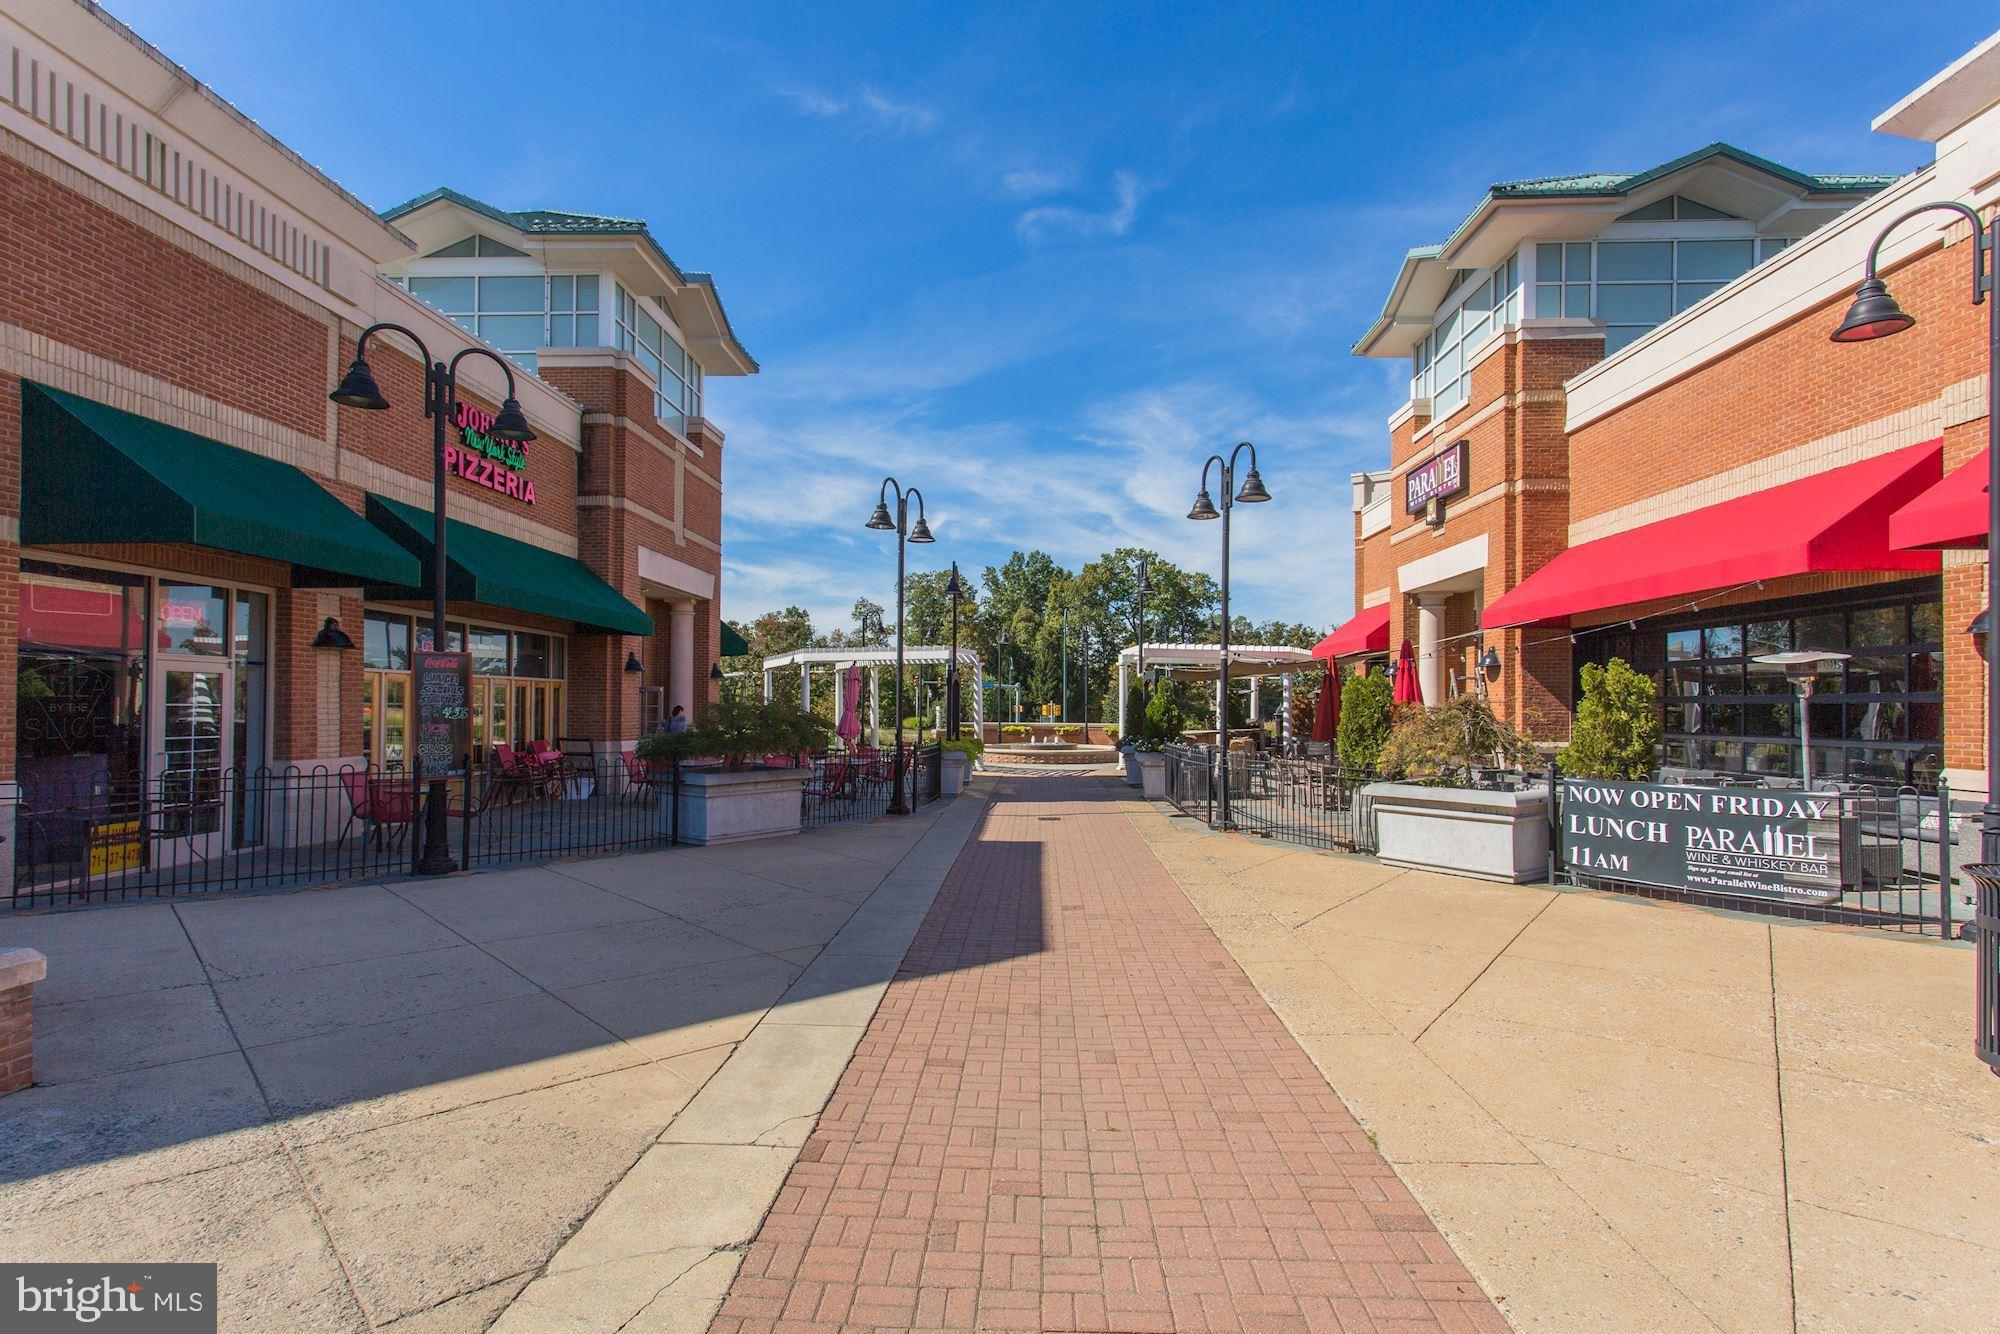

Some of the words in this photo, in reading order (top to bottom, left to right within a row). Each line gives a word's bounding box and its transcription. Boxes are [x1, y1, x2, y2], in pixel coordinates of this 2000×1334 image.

[464, 426, 485, 451] New
[445, 444, 537, 506] PIZZERIA
[160, 604, 203, 623] OPEN
[423, 672, 460, 685] LUNCH
[65, 703, 88, 713] THE
[1568, 785, 1625, 806] NOW
[1630, 789, 1702, 812] OPEN
[1711, 794, 1830, 821] FRIDAY
[1569, 814, 1669, 844] LUNCH
[1685, 824, 1827, 861] PARALLEL
[1570, 845, 1629, 872] 11AM
[1686, 851, 1718, 864] WINE
[1722, 854, 1731, 865] &
[1735, 856, 1796, 872] WHISKEY
[1800, 862, 1828, 875] BAR
[1686, 874, 1829, 898] www.ParallelWineBistro.com
